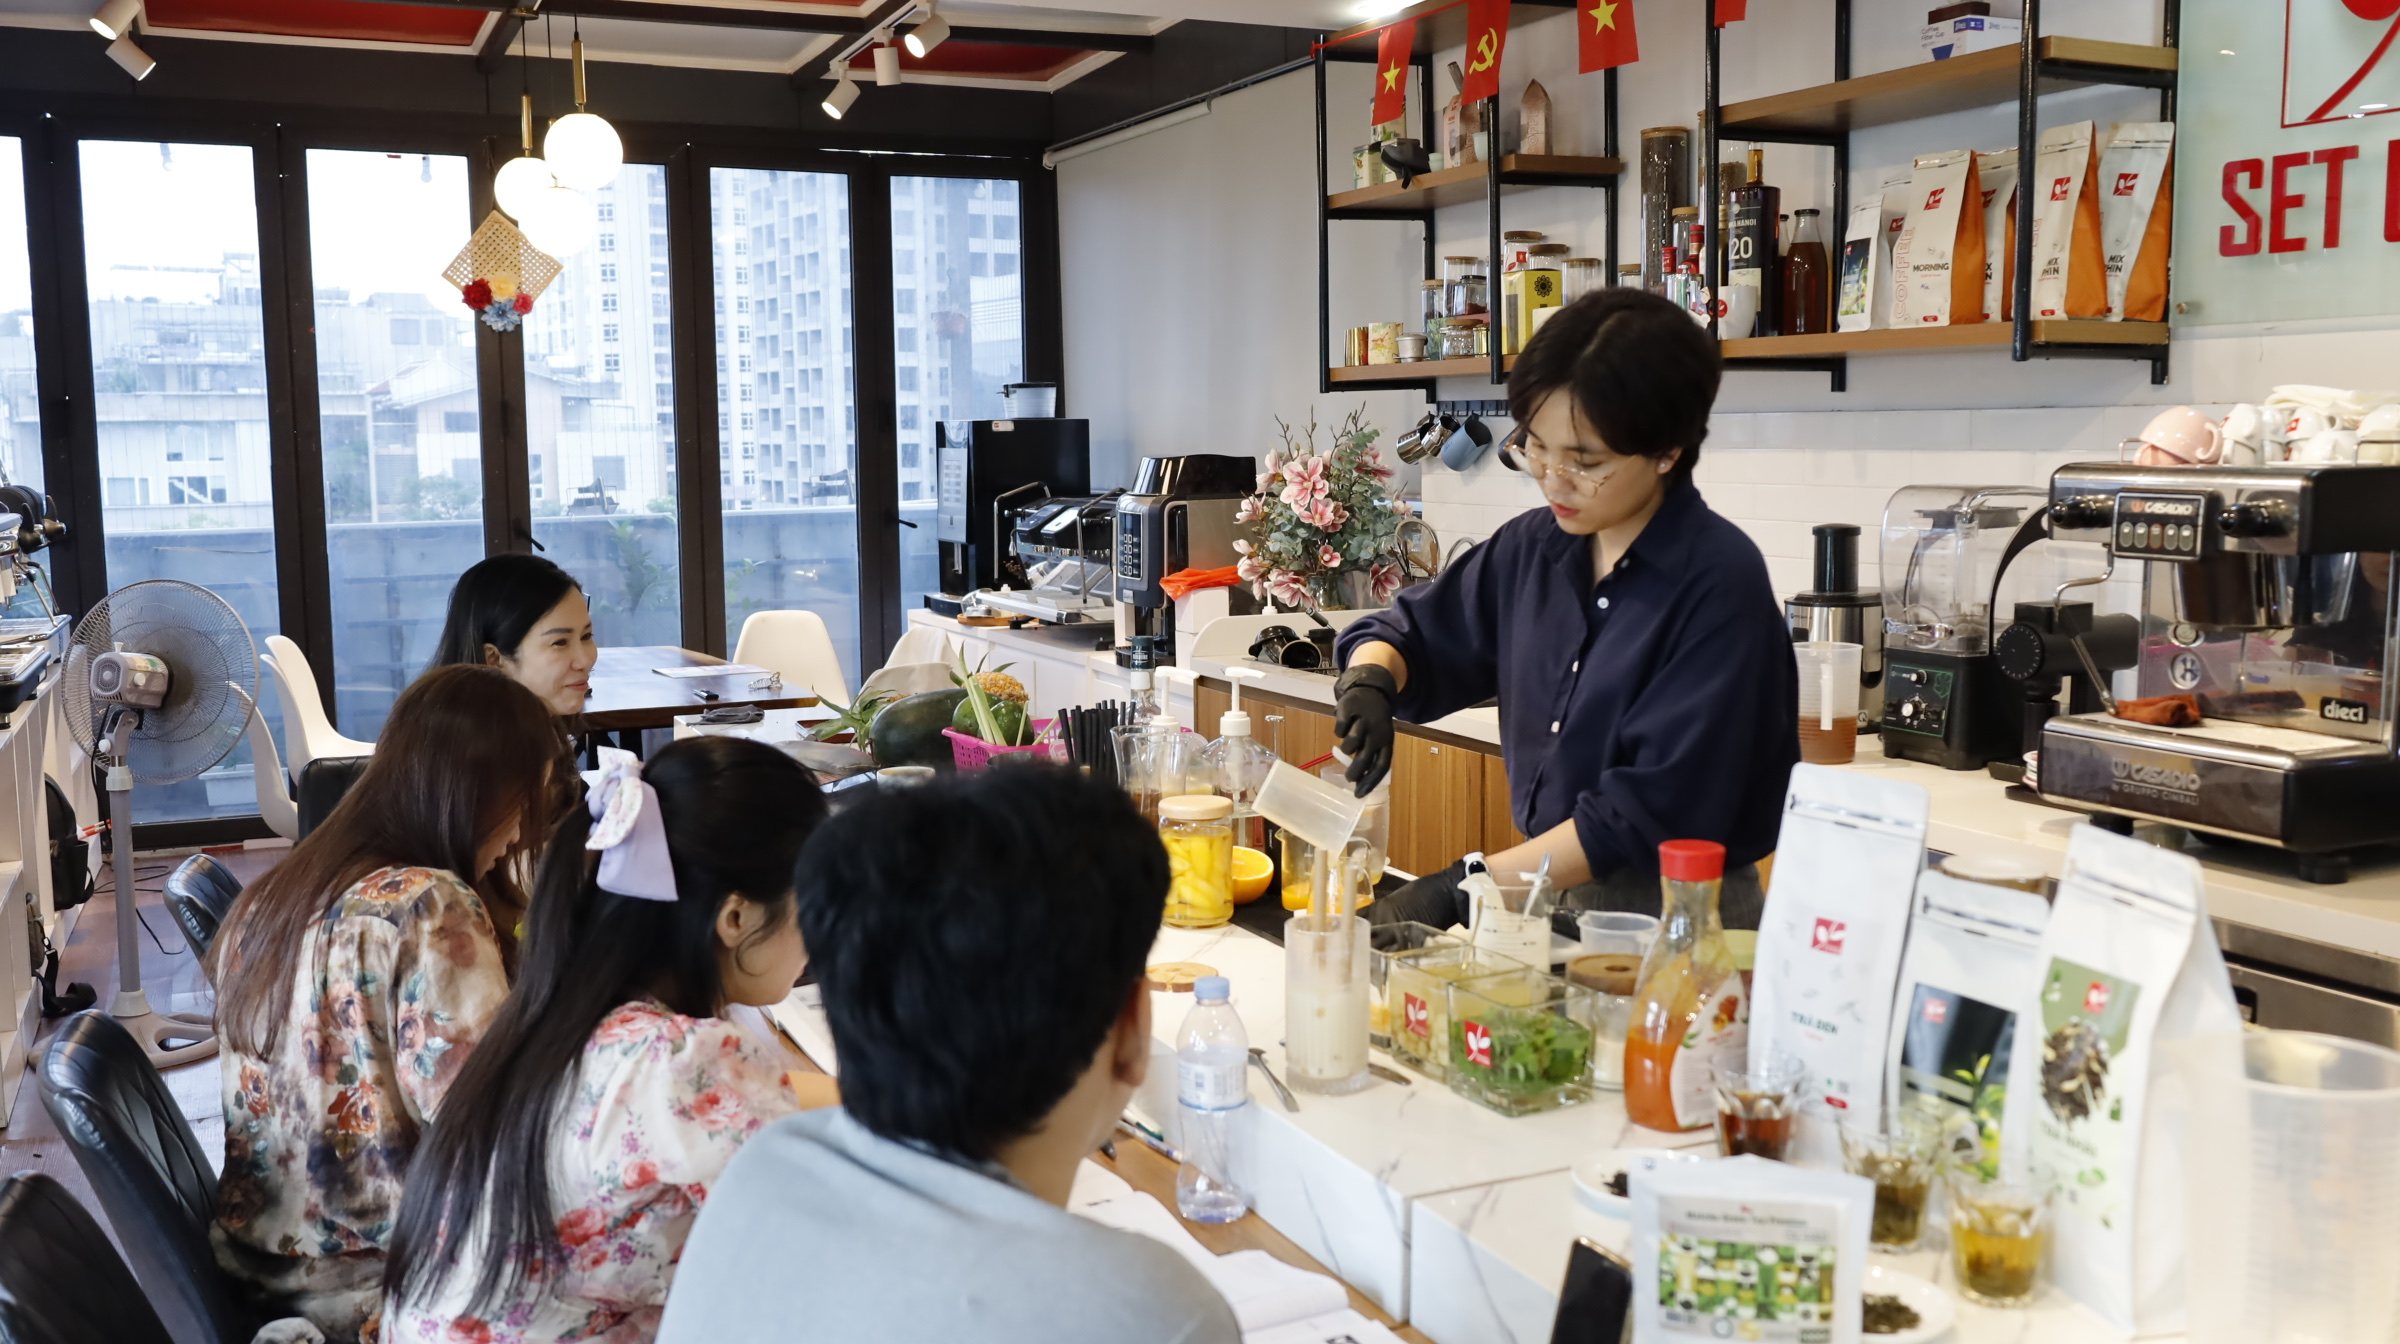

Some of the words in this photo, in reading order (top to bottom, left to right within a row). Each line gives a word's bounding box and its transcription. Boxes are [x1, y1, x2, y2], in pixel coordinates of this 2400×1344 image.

[2219, 145, 2359, 257] SET
[1730, 236, 1752, 260] 20
[2108, 254, 2126, 263] MIX
[1913, 262, 1949, 272] MORNING
[2324, 700, 2364, 722] dieci
[2122, 783, 2159, 798] GRUPPO
[2161, 791, 2200, 806] CIMBALI
